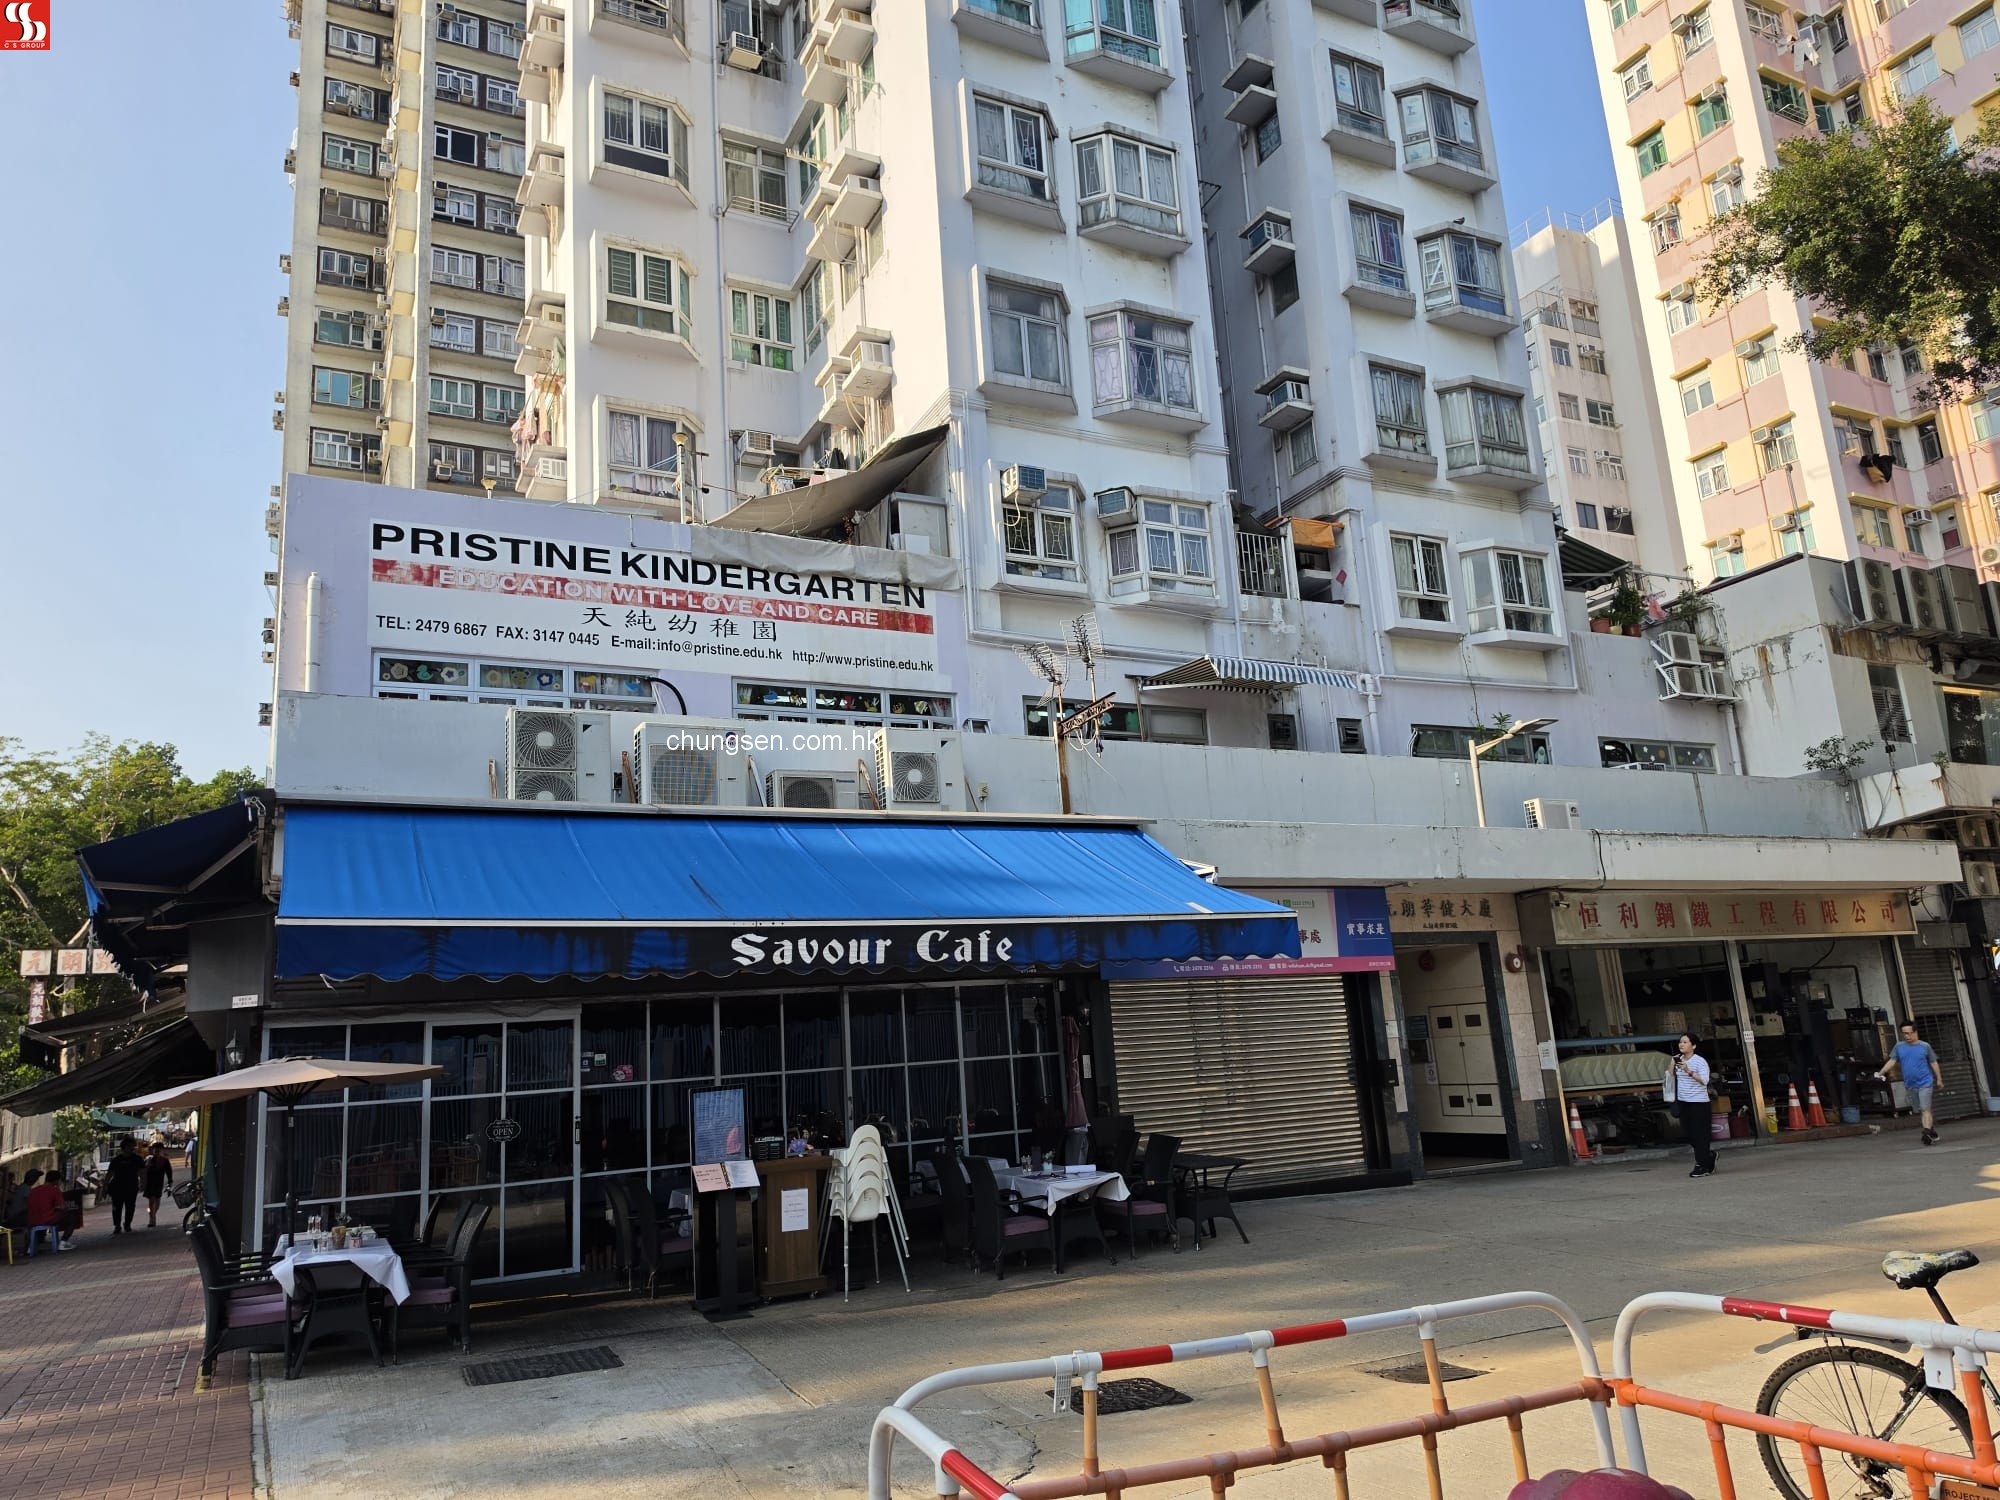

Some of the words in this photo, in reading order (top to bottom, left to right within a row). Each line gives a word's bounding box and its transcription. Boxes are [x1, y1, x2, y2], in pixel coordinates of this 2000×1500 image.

[372, 523, 611, 575] PRISTINE
[621, 551, 925, 609] KINDERGARTEN
[438, 568, 602, 599] EDUCATION
[611, 586, 677, 606] WITH
[688, 594, 753, 614] LOVE
[760, 601, 810, 620] AND
[818, 607, 879, 626] CARE
[582, 607, 777, 642] 天純幼稚園
[376, 615, 411, 630] TEL:
[415, 619, 449, 633] 2479
[454, 622, 487, 636] 6867
[496, 626, 529, 640] FAX:
[533, 629, 564, 643] 3147
[569, 631, 600, 646] 0445
[611, 635, 783, 660] E-mail:info@pristine.edu.hk
[792, 650, 934, 672] http://www.pristine.edu.hk
[1578, 899, 1896, 929] 恒利鋼鐵工程有限公司
[731, 933, 892, 966] Savour
[916, 929, 1013, 962] Cafe
[493, 1128, 513, 1136] OPEN
[1943, 1489, 1980, 1500] ROJECT
